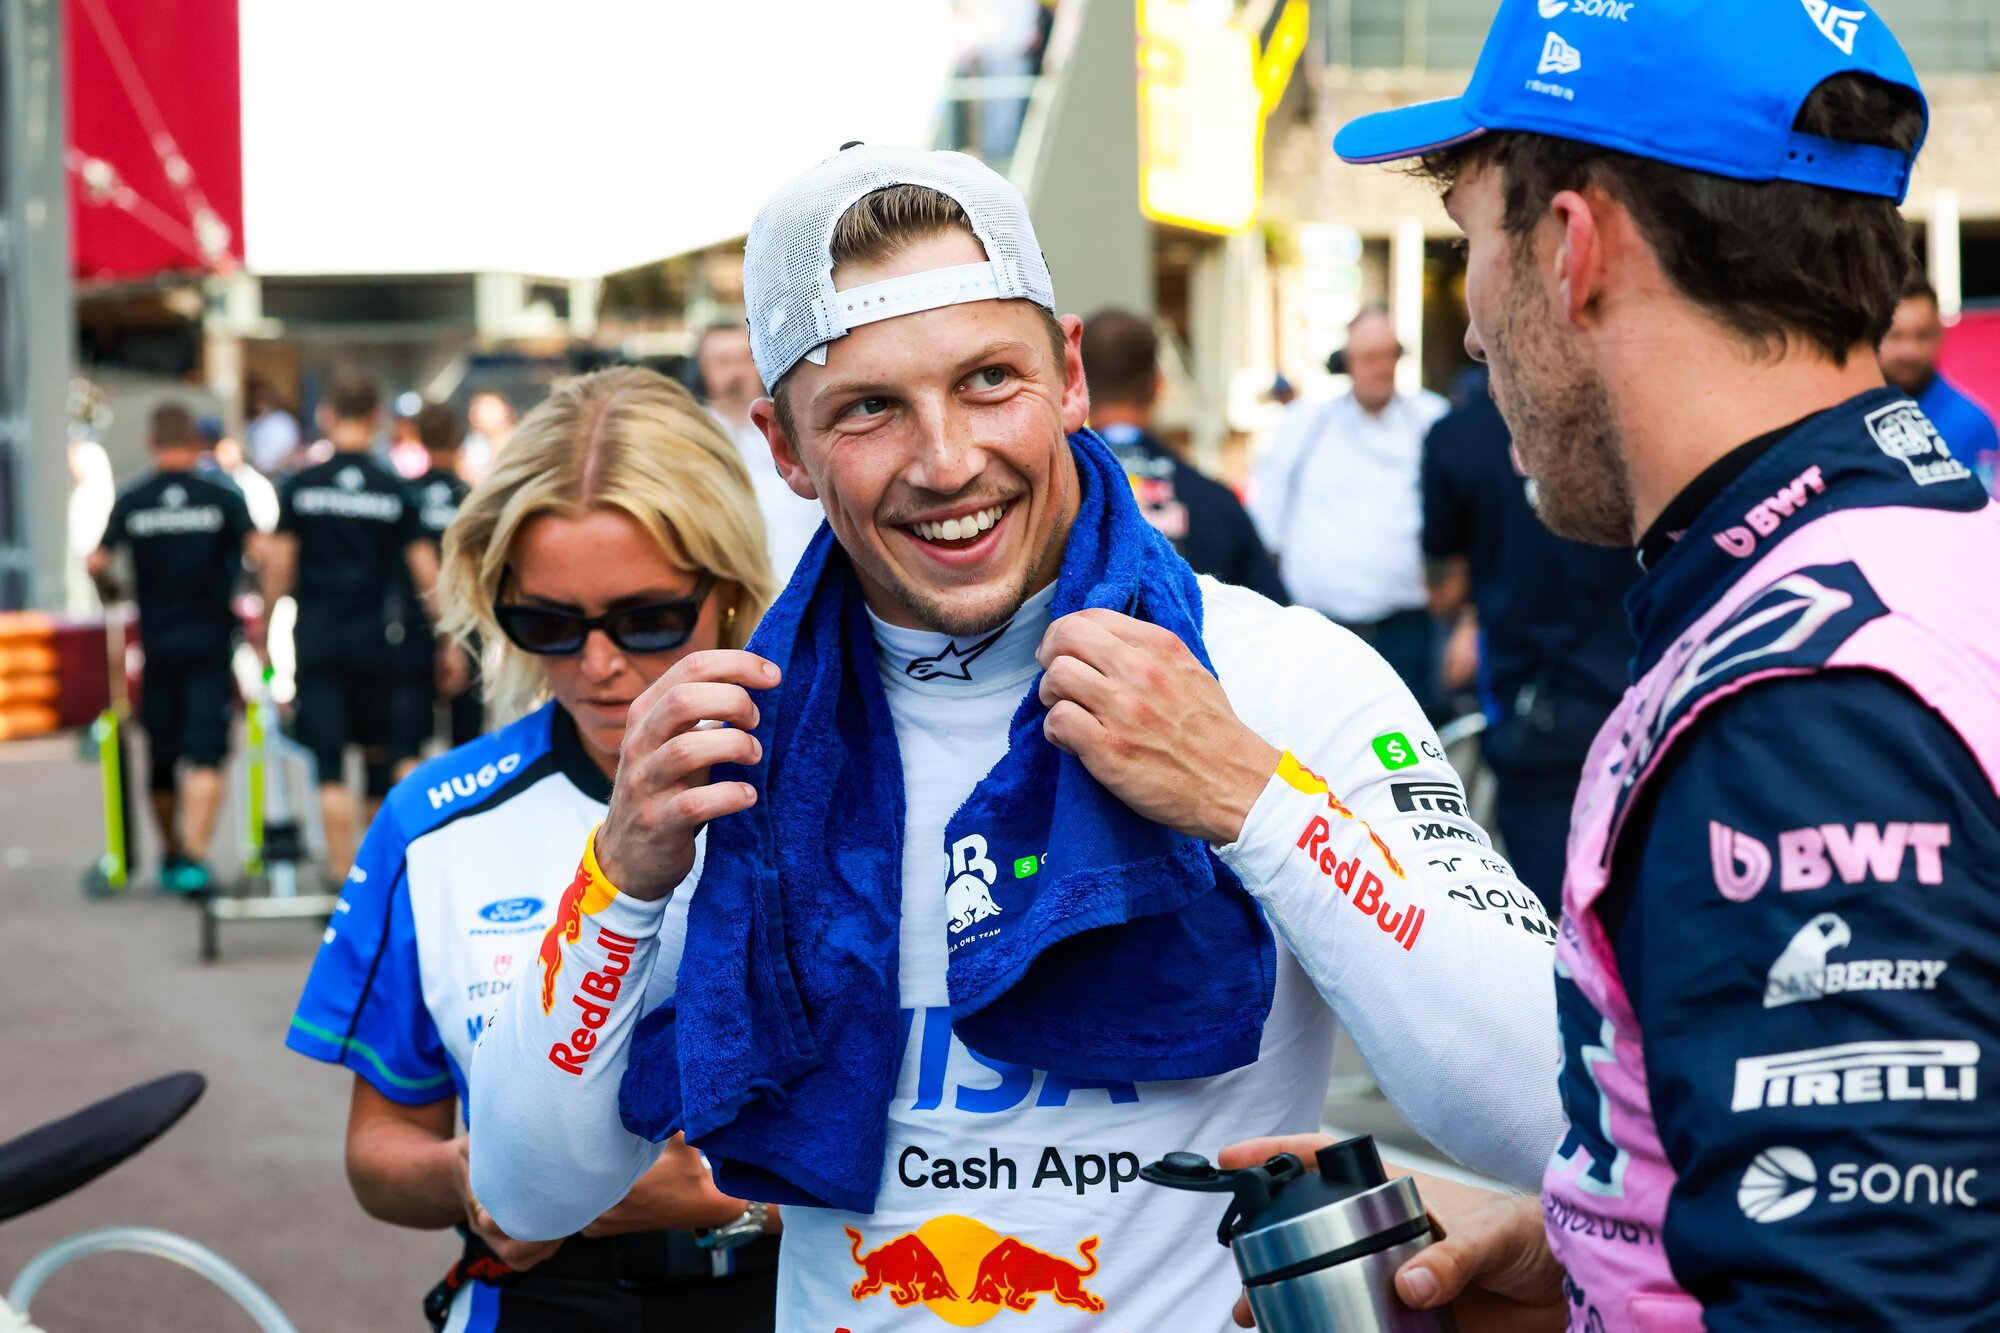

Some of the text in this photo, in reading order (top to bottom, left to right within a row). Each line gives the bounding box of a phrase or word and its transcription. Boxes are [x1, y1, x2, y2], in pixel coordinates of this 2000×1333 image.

[1744, 464, 1826, 538] BWT
[427, 752, 521, 809] HUGO
[1297, 814, 1425, 951] Red Bull
[1778, 821, 1951, 892] BWT
[960, 928, 1001, 947] ONE TEAM
[548, 926, 638, 1076] Red Bull
[1731, 1039, 1981, 1112] PIRELLI
[898, 1145, 1140, 1195] Cash App
[1828, 1162, 1979, 1207] SONIC
